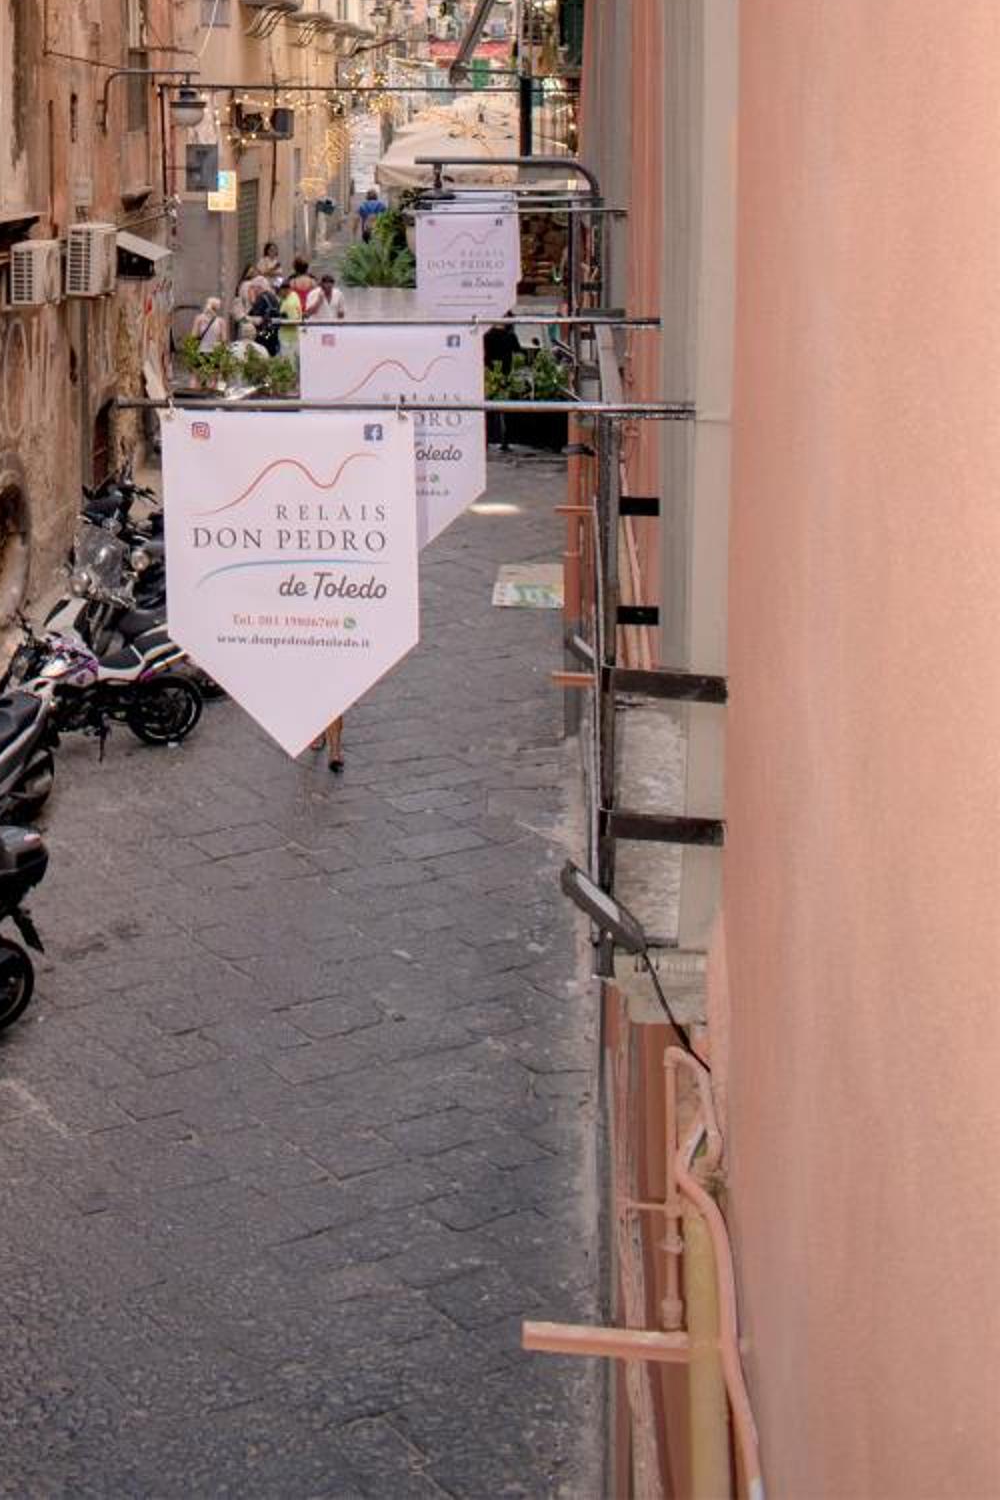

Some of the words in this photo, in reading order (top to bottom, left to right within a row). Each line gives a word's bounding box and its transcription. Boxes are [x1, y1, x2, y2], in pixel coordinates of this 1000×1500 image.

[275, 503, 387, 522] RELAIS
[192, 526, 263, 549] DON
[277, 528, 387, 553] PEDRO
[278, 573, 308, 597] de
[312, 571, 388, 601] Toledo
